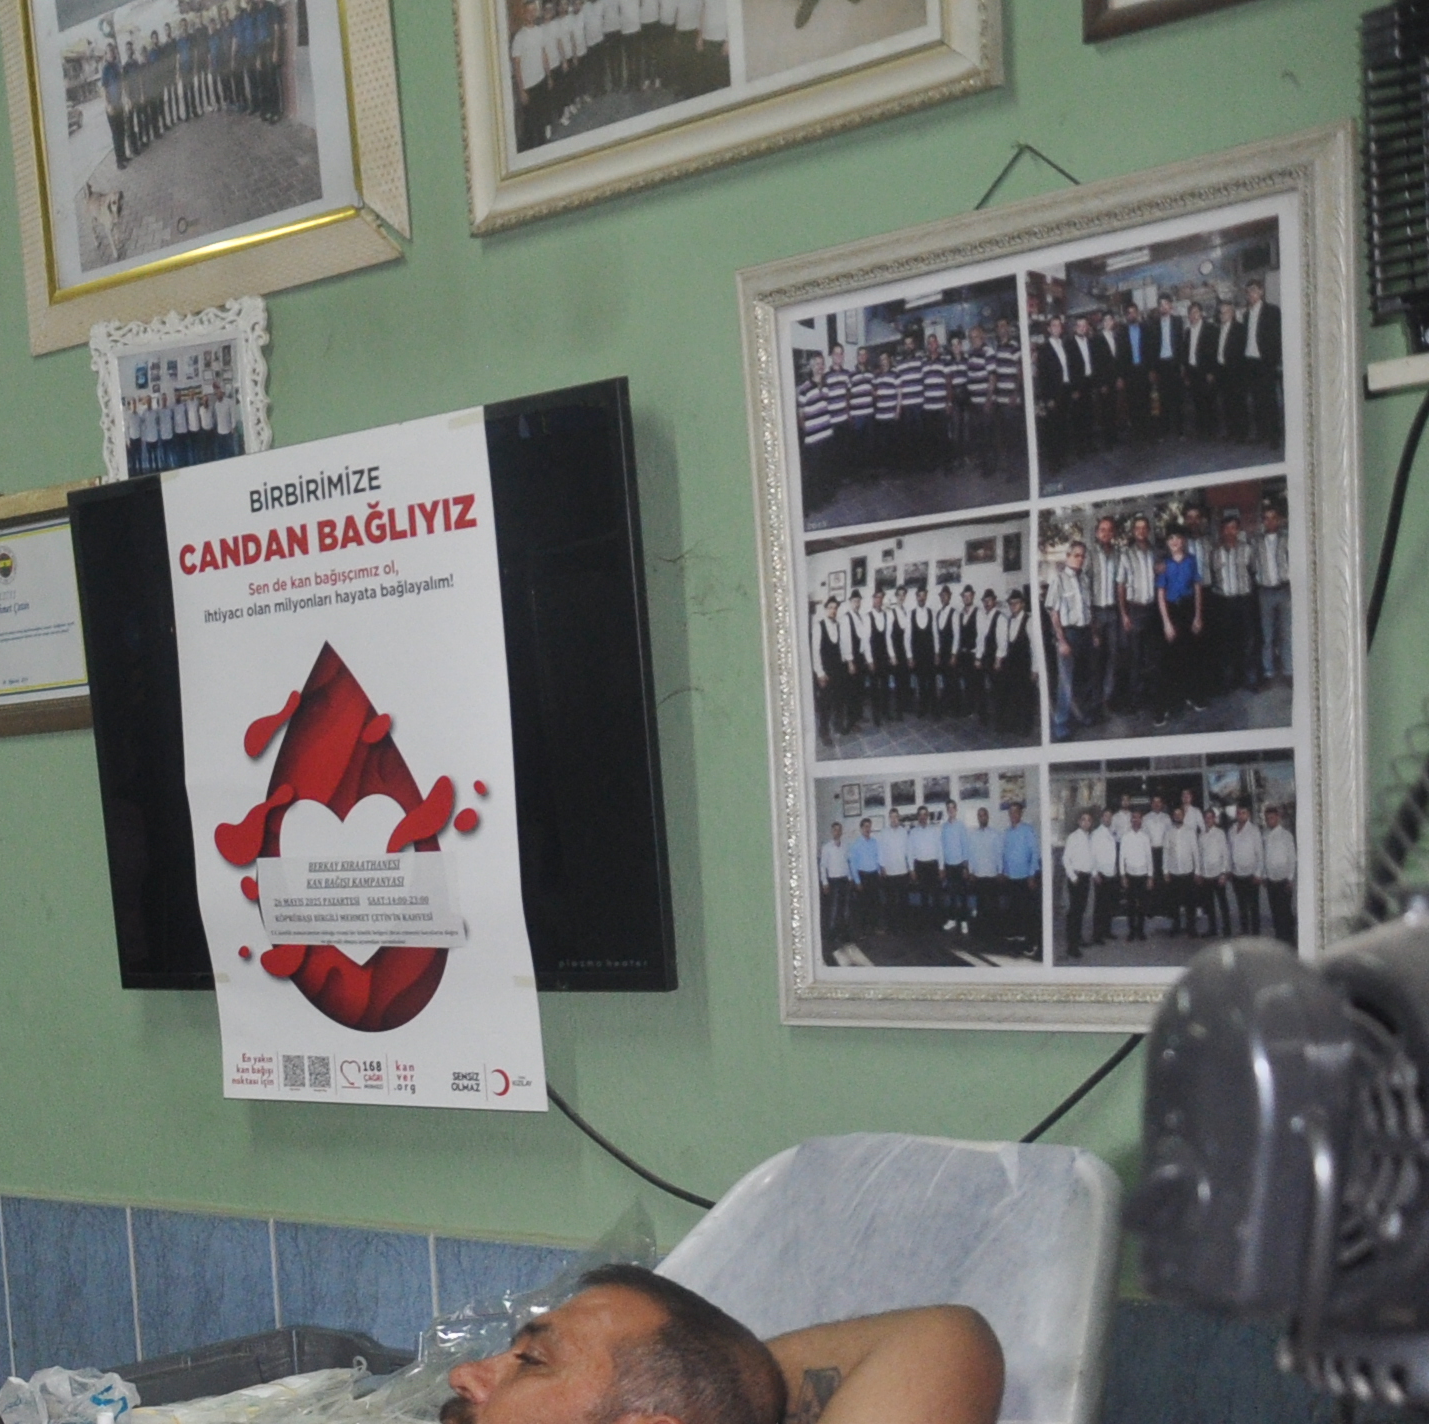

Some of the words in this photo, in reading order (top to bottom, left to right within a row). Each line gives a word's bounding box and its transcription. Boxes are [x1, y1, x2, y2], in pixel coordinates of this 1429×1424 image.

[249, 466, 382, 513] BİRBİRİMİZE
[179, 524, 310, 575] CANDAN
[317, 493, 477, 553] BAĞLIYIZ
[248, 581, 270, 595] Sen
[272, 577, 288, 592] de
[291, 573, 311, 589] kan
[315, 563, 379, 587] bağışçımız
[204, 606, 244, 624] ihtiyacı
[247, 602, 272, 617] olan
[274, 592, 332, 613] milyonları
[335, 587, 377, 607] hayata
[380, 573, 454, 599] bağlayalım!
[309, 861, 340, 872] BERKAY
[307, 878, 323, 889] KAN
[242, 1053, 252, 1062] En
[236, 1064, 249, 1074] kan
[362, 1061, 382, 1072] 168
[395, 1060, 415, 1072] kan
[397, 1074, 414, 1082] ver
[394, 1083, 416, 1094] .org
[451, 1082, 481, 1092] OLMAZ
